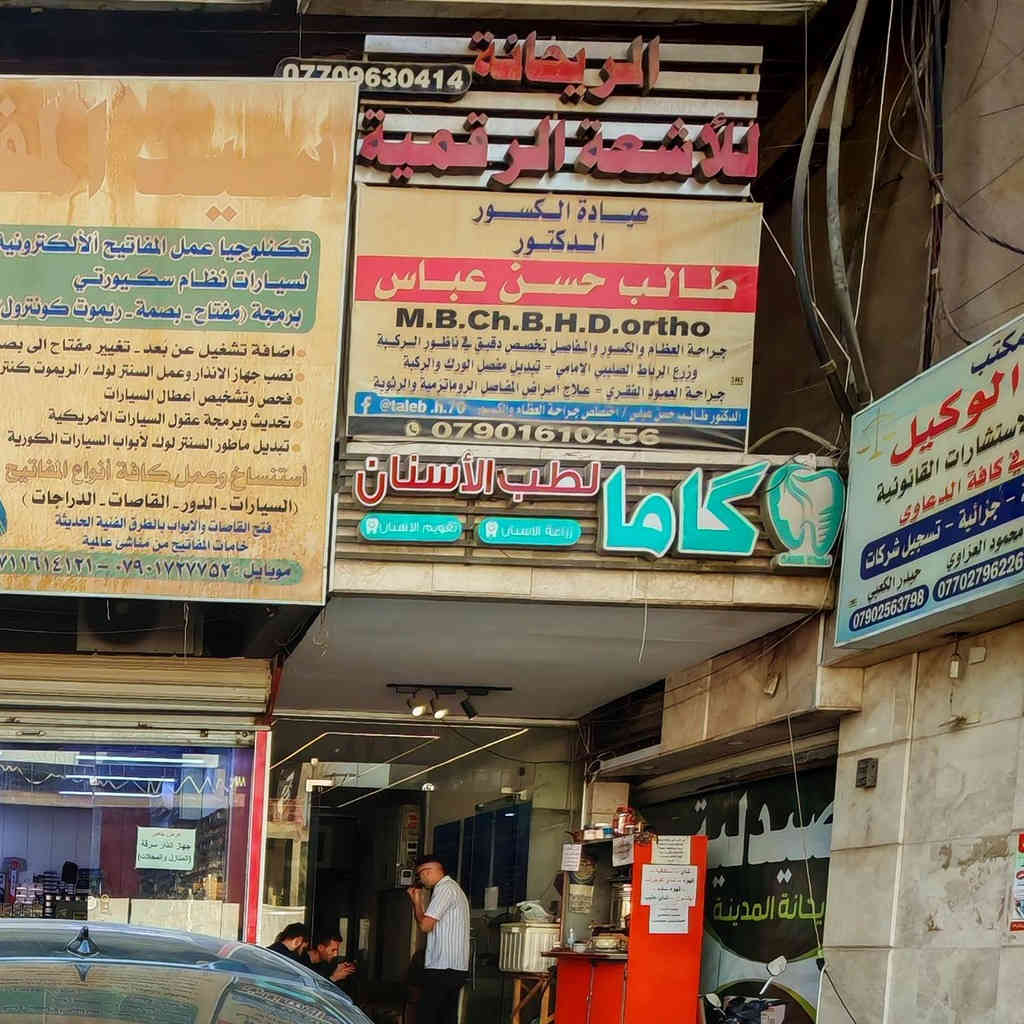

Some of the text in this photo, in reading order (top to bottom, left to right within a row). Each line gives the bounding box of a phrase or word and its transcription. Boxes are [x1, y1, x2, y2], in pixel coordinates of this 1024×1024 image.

[283, 63, 464, 90] 07709630414
[470, 31, 660, 105] الريحانة
[357, 109, 565, 190] الرقمية
[472, 199, 649, 227] عيادة الكسور
[103, 236, 166, 258] المفاتيح
[170, 237, 213, 259] عمل
[512, 229, 605, 256] الدكتور
[74, 268, 309, 294] لسيارات نظام سكيورتي
[374, 259, 736, 305] طالب حسن عباس
[73, 298, 121, 321] ريموت
[136, 301, 182, 323] بصمة
[252, 302, 302, 326] برمجة
[396, 307, 711, 336] M.B.Ch.B.H.D.ortho
[50, 339, 92, 353] مفتاح
[96, 340, 130, 356] تغيير
[171, 343, 194, 357] عن
[199, 341, 247, 358] تشغيل
[688, 343, 728, 360] جراحة
[34, 362, 81, 377] الريموت
[92, 364, 116, 379] لوك
[157, 366, 191, 381] وعمل
[232, 368, 260, 383] جهاز
[263, 369, 293, 384] نصب
[104, 386, 292, 407] فحص وتشخيص السيارات
[115, 411, 291, 431] تحديث وبرمجة عقول السيارات
[890, 362, 1020, 466] الوكيل
[8, 430, 58, 446] الكورية
[61, 432, 110, 448] السيارات
[151, 436, 175, 451] لوك
[432, 422, 661, 446] 07901610456
[216, 439, 250, 452] ماطور
[253, 440, 289, 455] تبديل
[968, 456, 1004, 490] كافة
[31, 489, 217, 513] الدور القاصات الدراجات
[354, 451, 772, 559] كاما لطب الأسنان
[55, 513, 94, 530] الحديثة
[208, 520, 250, 534] القاصات
[171, 538, 211, 554] المفاتيح
[864, 519, 942, 570] تسجيل شركات
[712, 895, 776, 927] المدينة
[776, 893, 827, 927] يحانة
